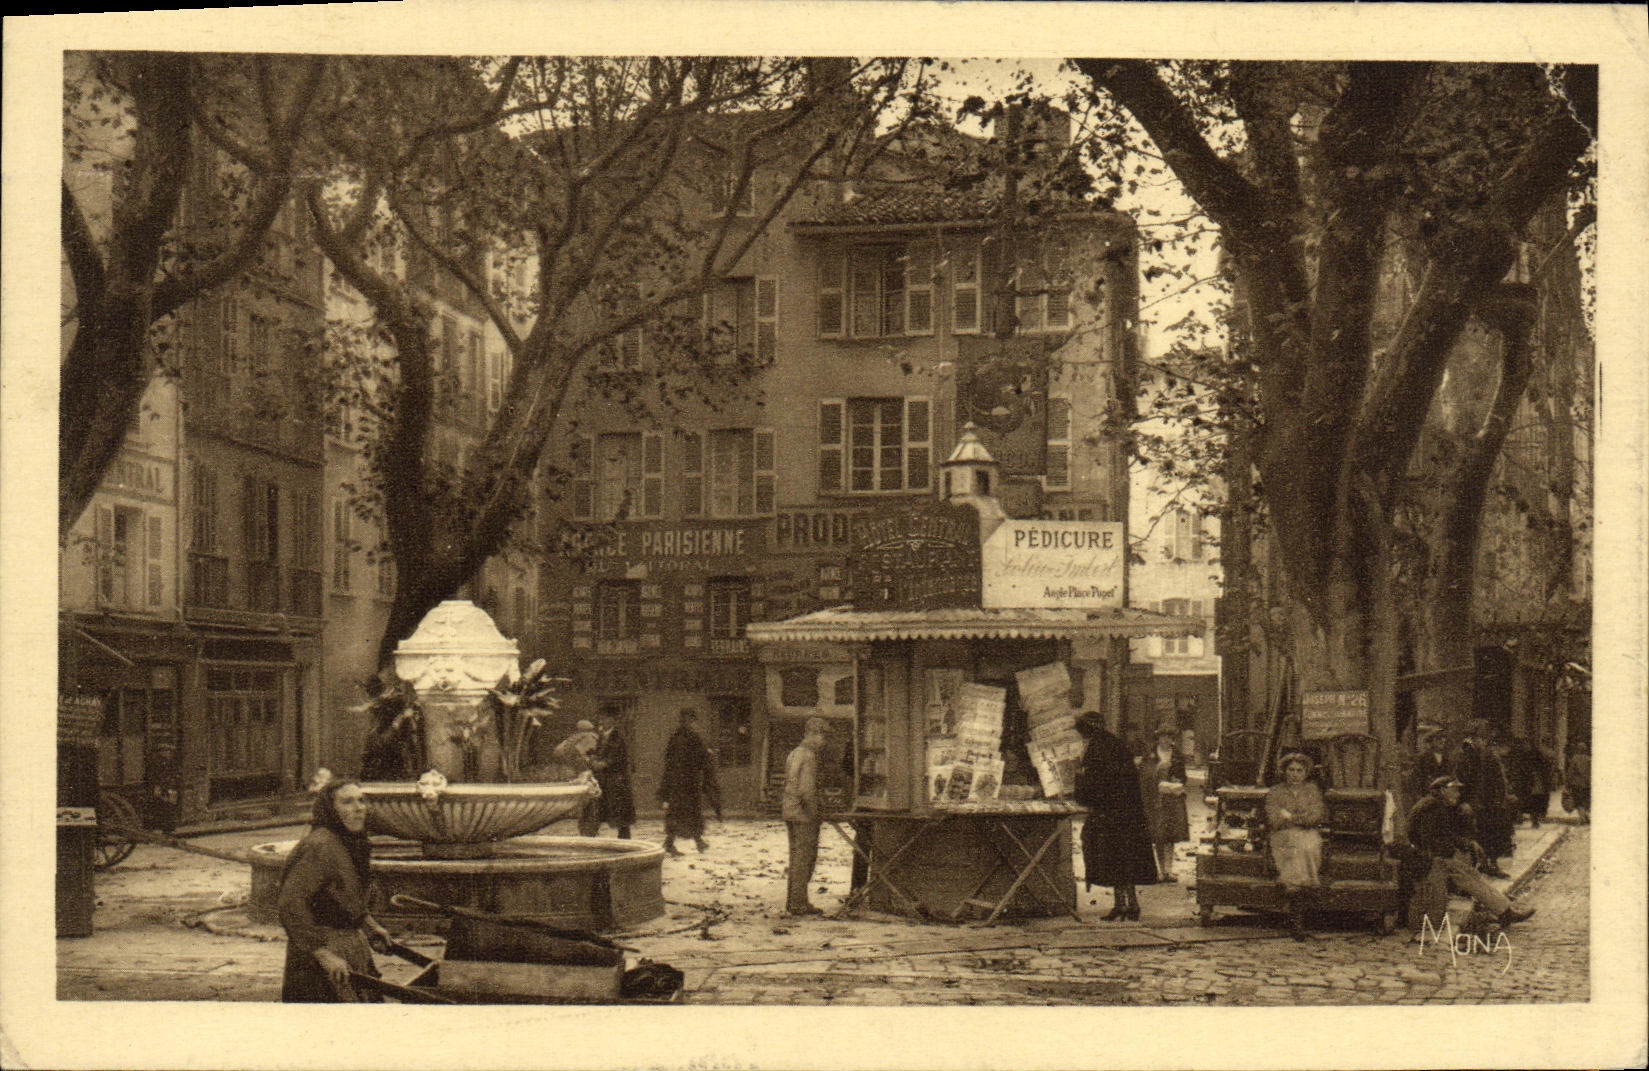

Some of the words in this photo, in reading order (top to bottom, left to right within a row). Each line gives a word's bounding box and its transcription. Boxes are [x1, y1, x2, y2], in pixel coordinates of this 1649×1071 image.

[642, 529, 745, 556] PARISIENNE
[1014, 526, 1114, 549] PÉDICURE
[1043, 586, 1067, 600] Angle
